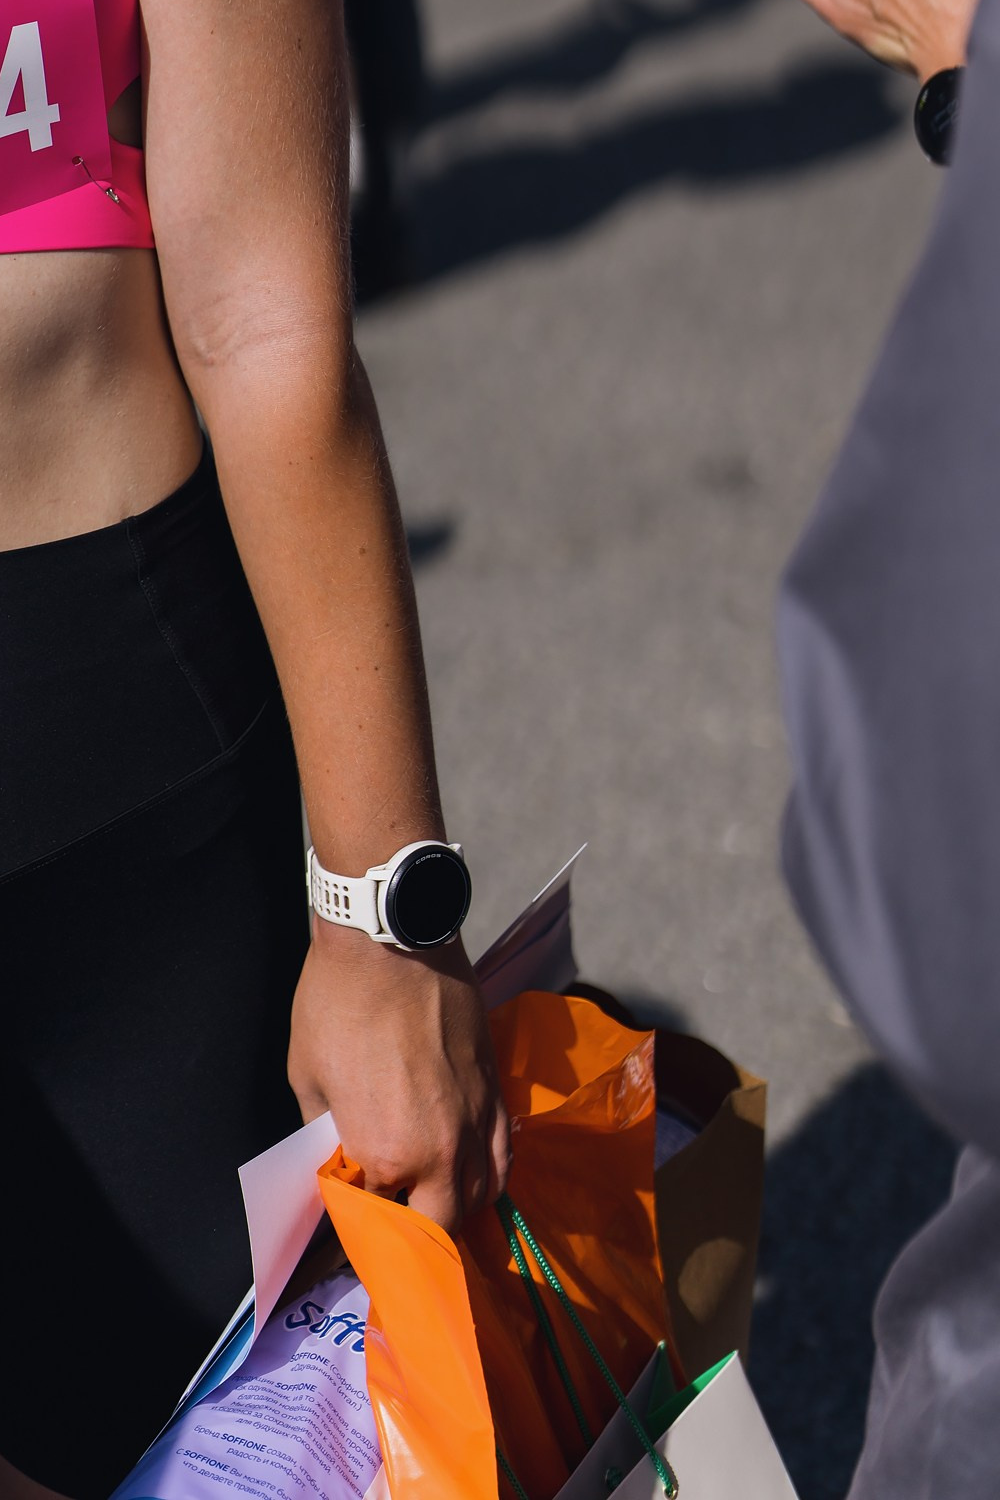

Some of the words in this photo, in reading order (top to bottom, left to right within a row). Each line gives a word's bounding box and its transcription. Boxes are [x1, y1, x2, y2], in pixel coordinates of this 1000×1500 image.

[274, 1382, 318, 1394] SOFFIONE
[252, 1411, 263, 1419] за
[263, 1414, 313, 1439] сохранение
[312, 1438, 336, 1466] нашей
[305, 1395, 315, 1403] то
[325, 1412, 346, 1439] время
[220, 1433, 268, 1453] SOFFIONE
[266, 1448, 298, 1468] создан,
[299, 1465, 321, 1493] чтобы
[252, 1420, 290, 1438] будущих
[290, 1434, 332, 1476] поколений.
[281, 1412, 323, 1437] относимся
[327, 1443, 360, 1481] экологии
[182, 1461, 198, 1472] что
[197, 1468, 234, 1487] делаете
[183, 1449, 231, 1472] SOFFIONE
[229, 1467, 243, 1478] Вы
[243, 1475, 277, 1492] можете
[226, 1447, 262, 1463] радость
[269, 1460, 307, 1492] комфорт.
